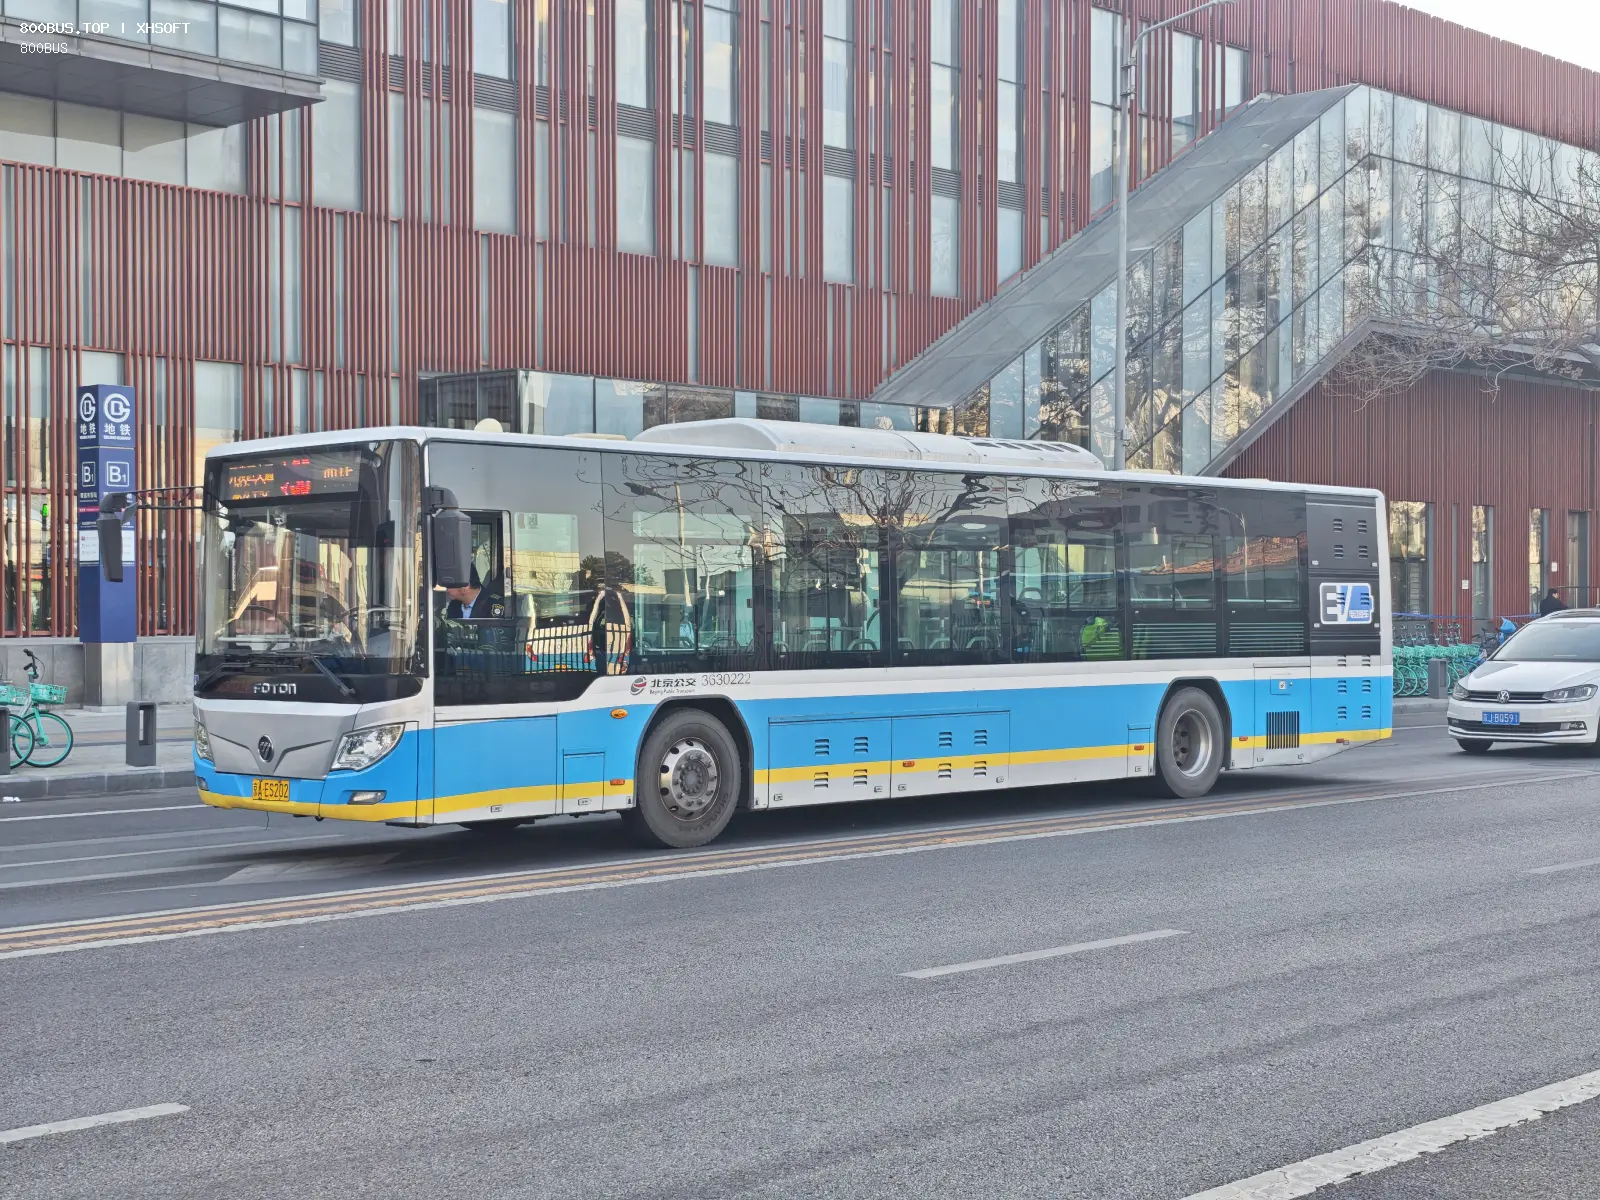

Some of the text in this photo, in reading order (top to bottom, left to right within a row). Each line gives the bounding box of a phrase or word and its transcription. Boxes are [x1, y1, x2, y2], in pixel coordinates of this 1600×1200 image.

[80, 422, 97, 435] 地铁
[104, 423, 132, 436] 地铁
[84, 466, 94, 483] B1
[109, 465, 126, 483] B1
[650, 677, 697, 688] 北京公交
[701, 672, 751, 687] 3630222
[253, 682, 297, 695] FOTON
